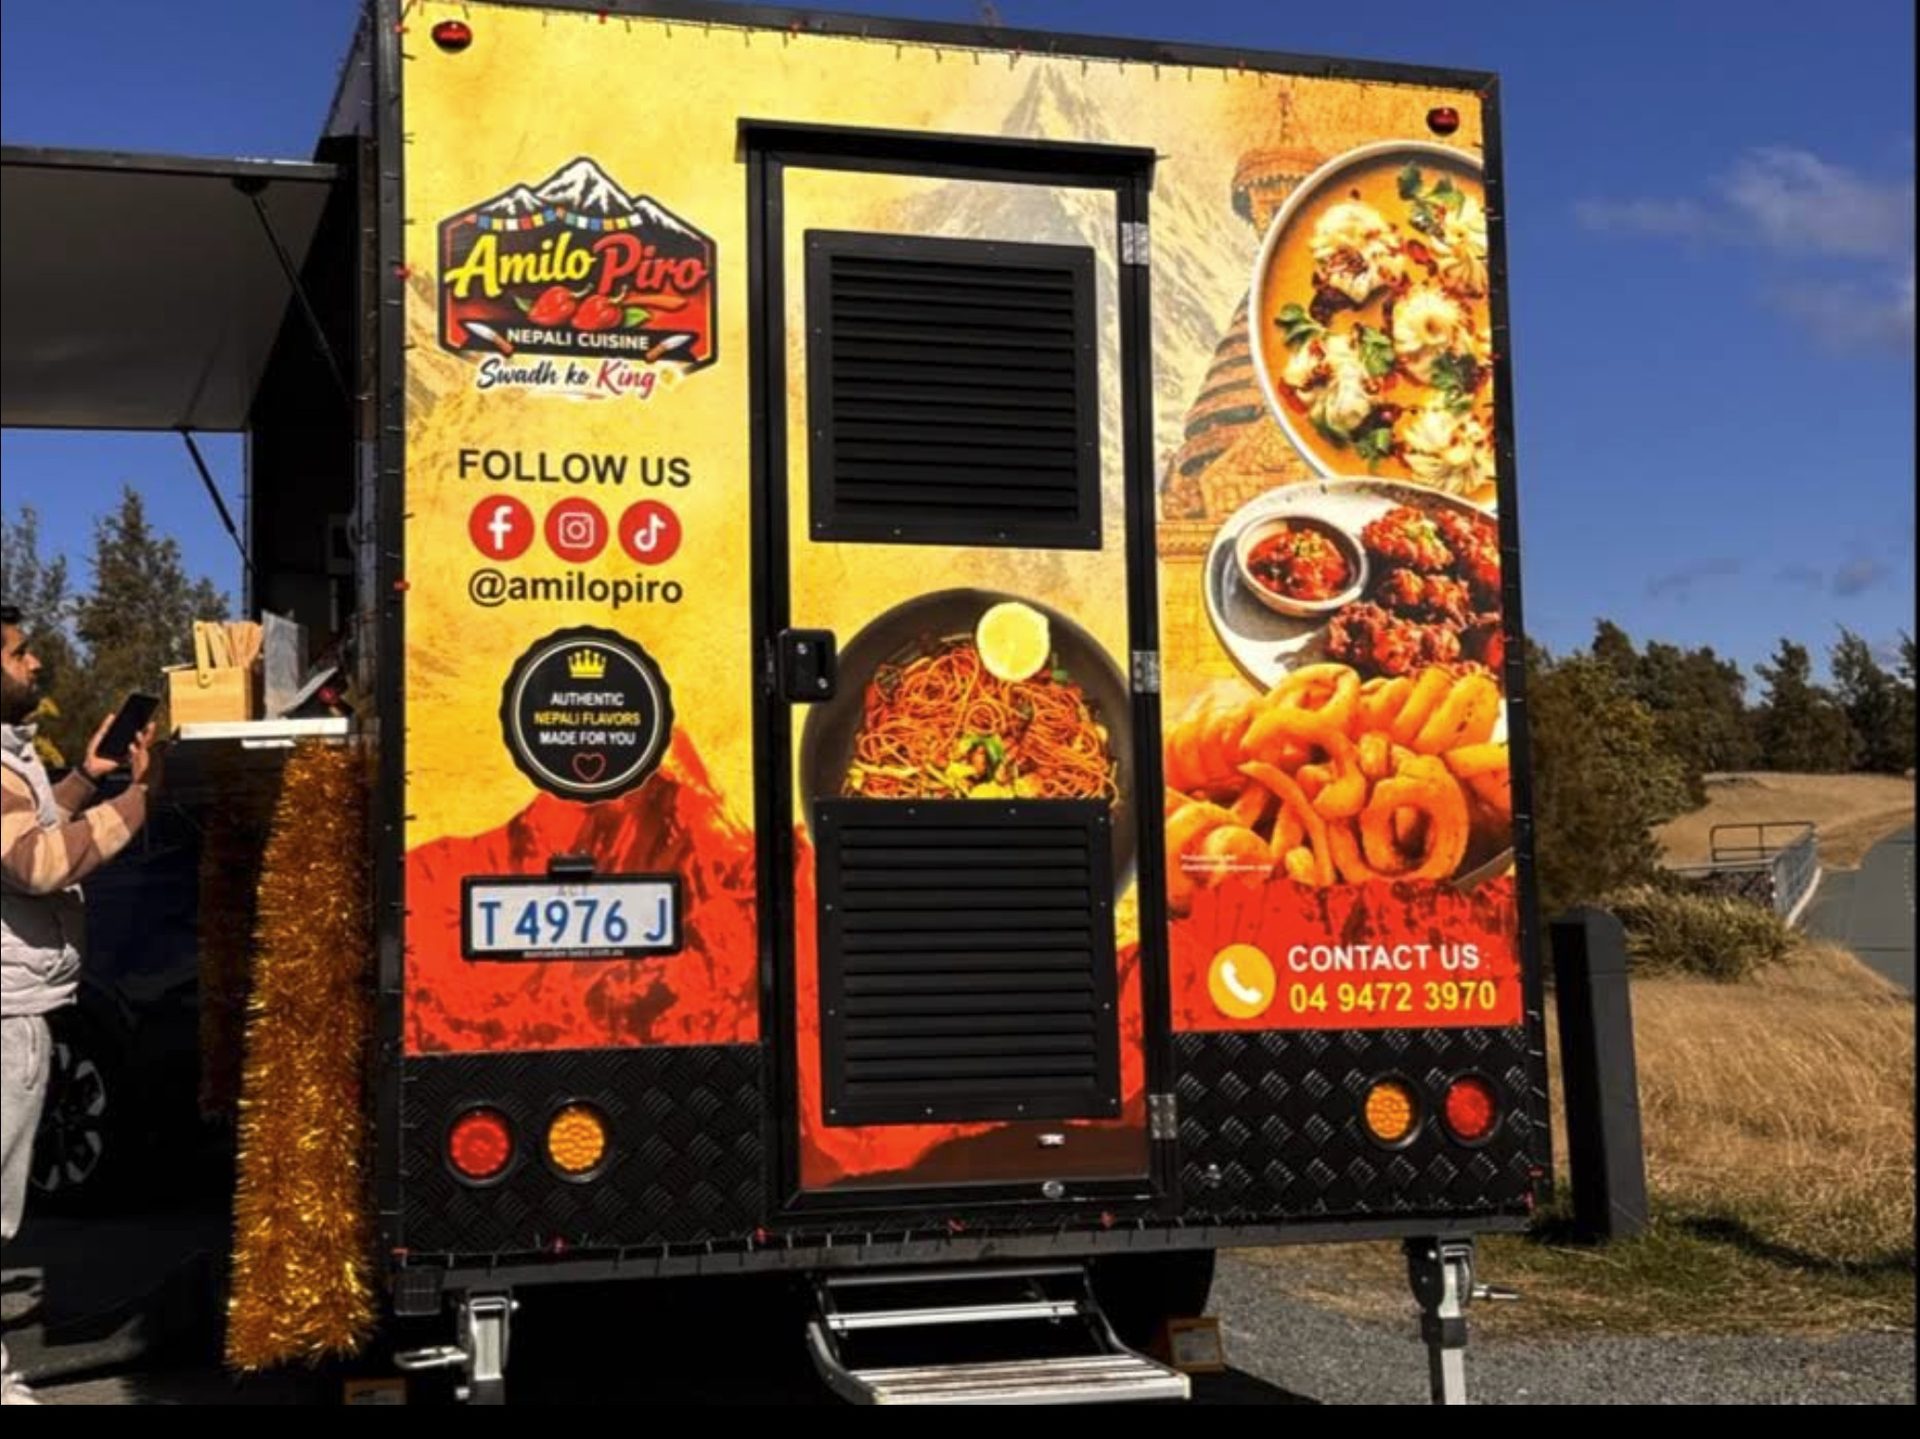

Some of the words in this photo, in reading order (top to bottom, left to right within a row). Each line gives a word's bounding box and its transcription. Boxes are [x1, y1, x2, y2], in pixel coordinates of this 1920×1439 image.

[444, 231, 597, 298] Amilo
[592, 233, 706, 294] Piro
[506, 328, 571, 345] NEPALI
[577, 333, 649, 350] CUISINE
[477, 357, 557, 389] Swadh
[565, 362, 590, 385] ko
[596, 361, 656, 399] King
[458, 449, 628, 485] FOLLOW
[640, 456, 692, 488] US
[468, 568, 684, 610] @amilopiro
[551, 692, 625, 706] AUTHENTIC
[534, 711, 580, 726] NEPALI
[583, 712, 641, 726] FLAVORS
[539, 731, 576, 745] MADE
[580, 731, 606, 745] FOR
[609, 731, 636, 745] YOU
[478, 902, 501, 946] T
[514, 900, 628, 945] 4976
[643, 898, 667, 942] J
[1288, 945, 1431, 972] CONTACT
[1440, 945, 1480, 970] US
[1289, 984, 1327, 1013] 04
[1336, 983, 1413, 1012] 9472
[1423, 980, 1497, 1010] 3970
